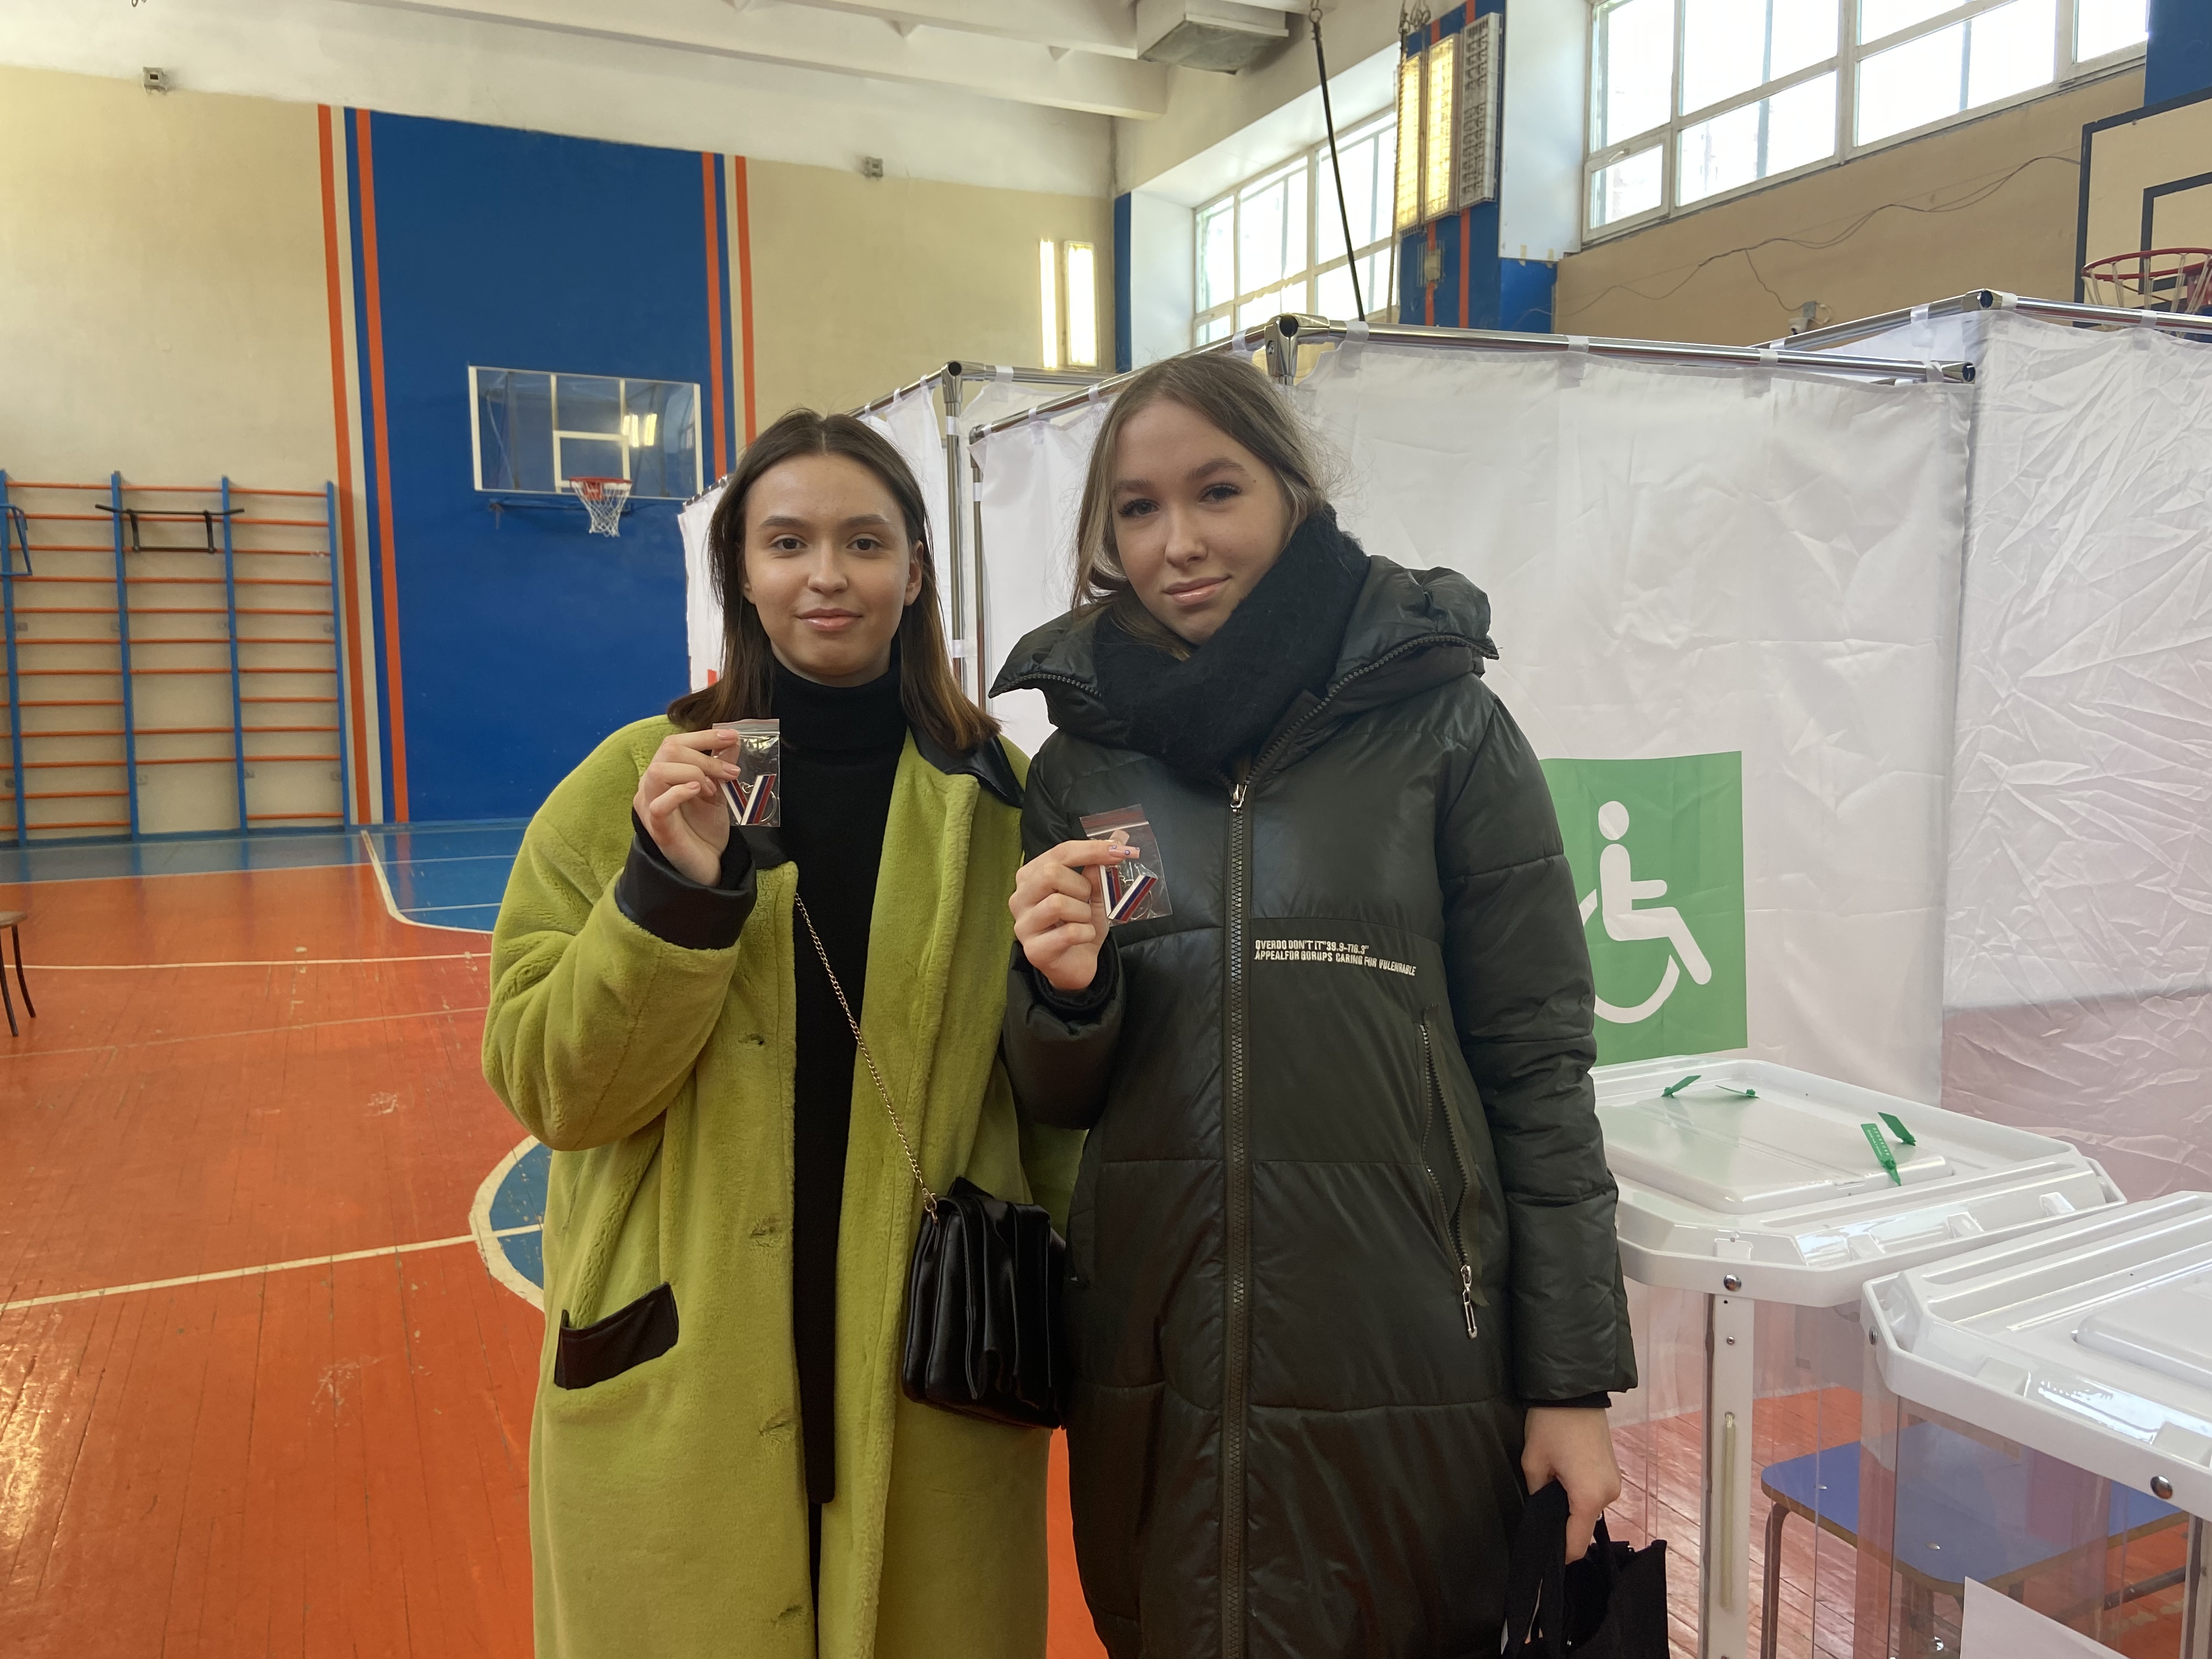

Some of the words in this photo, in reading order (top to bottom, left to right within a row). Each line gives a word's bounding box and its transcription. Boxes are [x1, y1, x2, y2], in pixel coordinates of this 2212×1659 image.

[1255, 940, 1287, 950] OVERDO
[1288, 940, 1313, 950] DON'T
[1301, 951, 1333, 962] GORUPS
[1335, 952, 1363, 965] CARING
[1364, 956, 1377, 968] FOR
[1379, 958, 1417, 976] VULENRABLE
